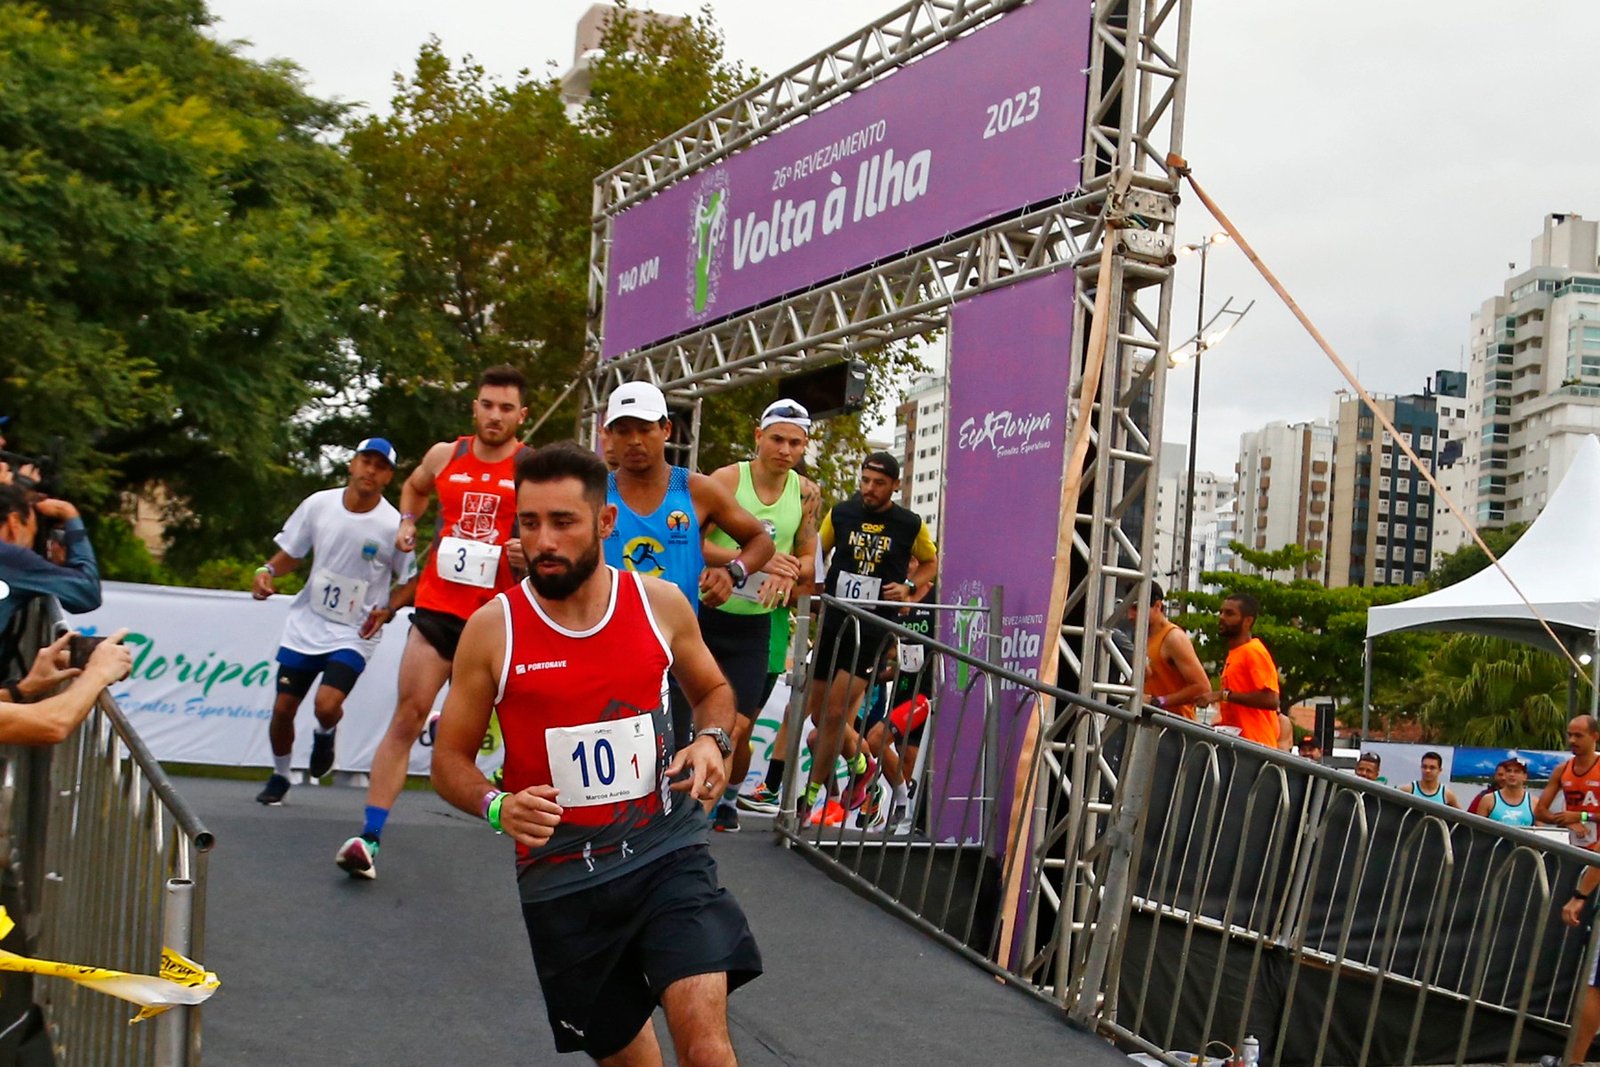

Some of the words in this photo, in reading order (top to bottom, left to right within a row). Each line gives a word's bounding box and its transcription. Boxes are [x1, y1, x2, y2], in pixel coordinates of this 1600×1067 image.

[983, 85, 1041, 139] 2023
[793, 119, 887, 181] REVEZAMENTO
[733, 199, 817, 271] Volta
[822, 170, 847, 235] à
[853, 148, 931, 222] Ilha
[618, 265, 638, 296] 140
[639, 255, 660, 287] KM
[848, 530, 892, 551] NEVER
[854, 546, 884, 563] GIVE
[454, 547, 467, 573] 3
[480, 562, 486, 577] 1
[323, 584, 341, 609] 13
[845, 579, 861, 600] 16
[1001, 628, 1041, 659] olta
[527, 660, 567, 671] PORTONAVE
[572, 738, 616, 788] 10
[630, 753, 640, 779] 1
